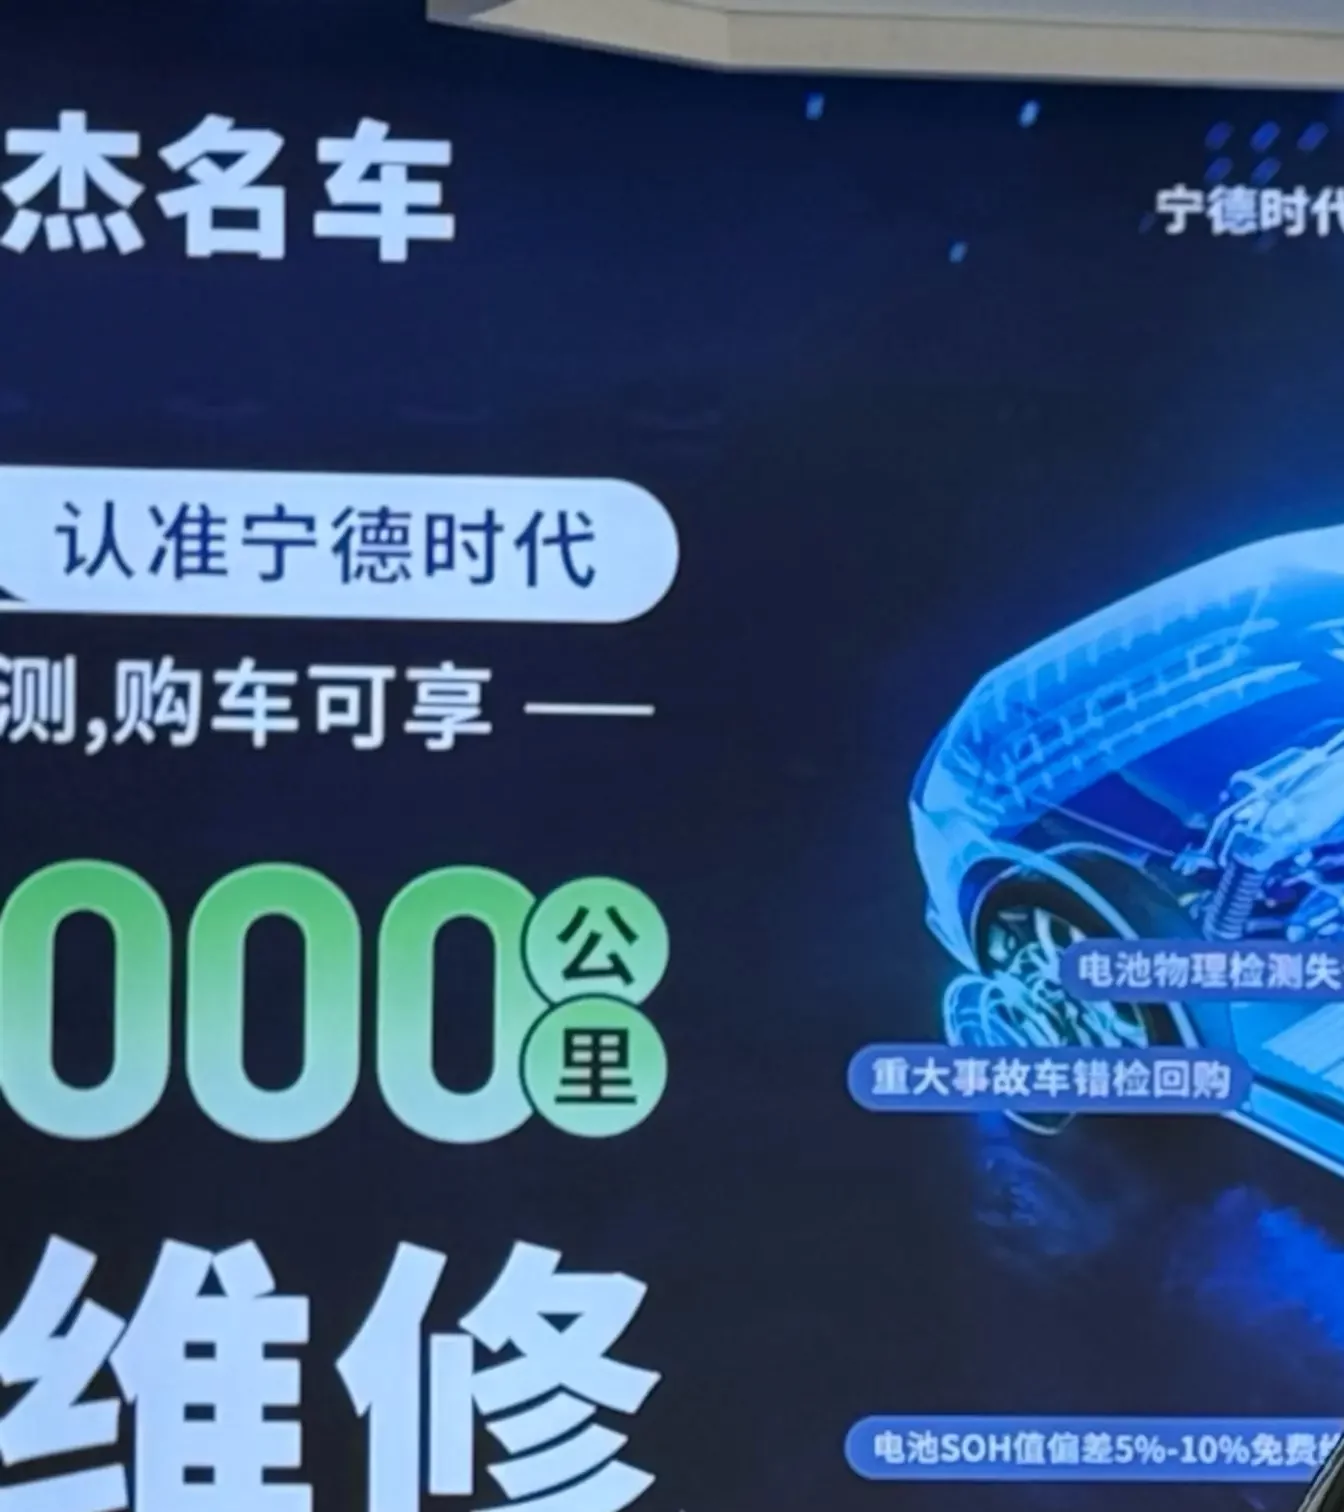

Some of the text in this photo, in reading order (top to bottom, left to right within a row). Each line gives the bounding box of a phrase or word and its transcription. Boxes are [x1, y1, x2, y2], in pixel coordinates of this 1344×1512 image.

[0, 110, 455, 262] 杰名车
[55, 500, 597, 588] 认准宁德时代
[554, 905, 638, 1105] 公里
[871, 1056, 1232, 1099] 重大事故车错检回购
